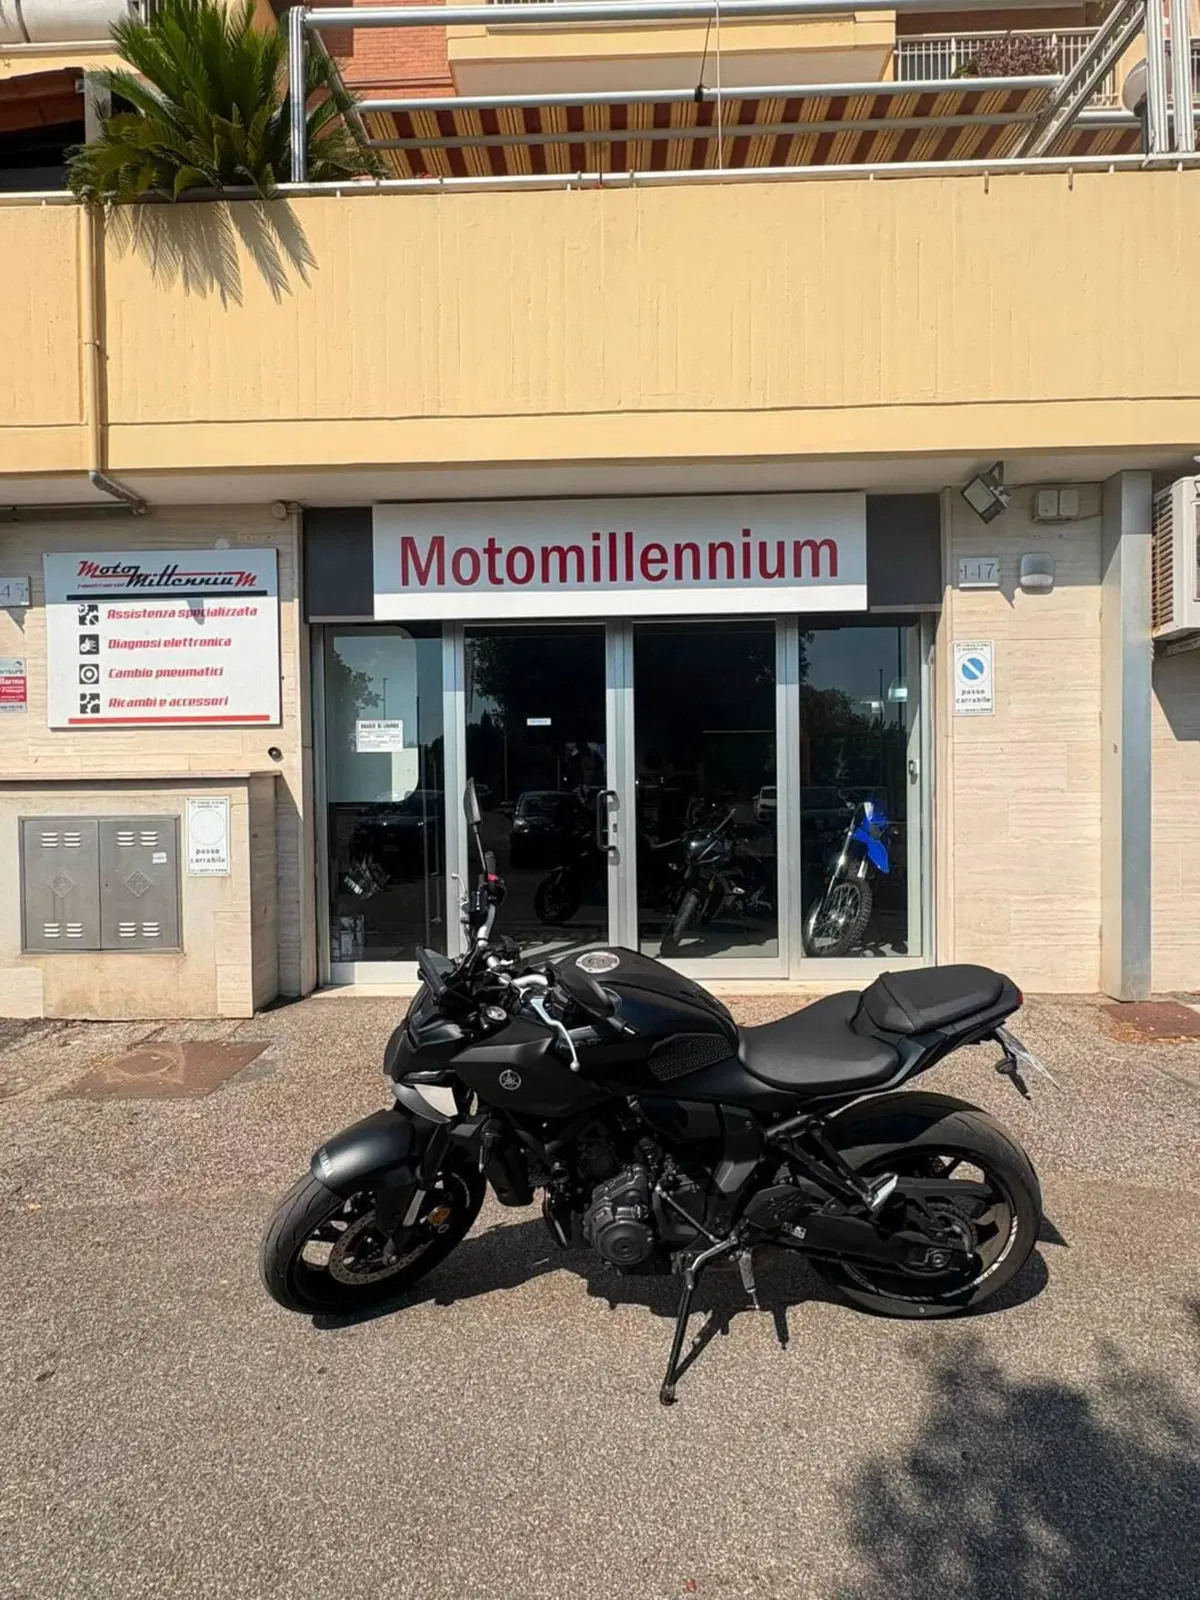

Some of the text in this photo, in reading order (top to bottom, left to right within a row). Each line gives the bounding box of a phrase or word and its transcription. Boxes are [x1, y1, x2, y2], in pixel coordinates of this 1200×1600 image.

[400, 528, 838, 587] Motomillennium
[77, 560, 141, 579] Moto
[107, 606, 258, 620] Assistenza specializzata
[107, 636, 232, 650] Diagnosi elettronica
[108, 666, 224, 679] Cambio pneumatici
[961, 688, 986, 697] passo
[108, 695, 229, 708] Ricambi e accessori
[956, 696, 991, 704] carrabile
[195, 848, 220, 856] passo
[190, 856, 226, 864] carrabile
